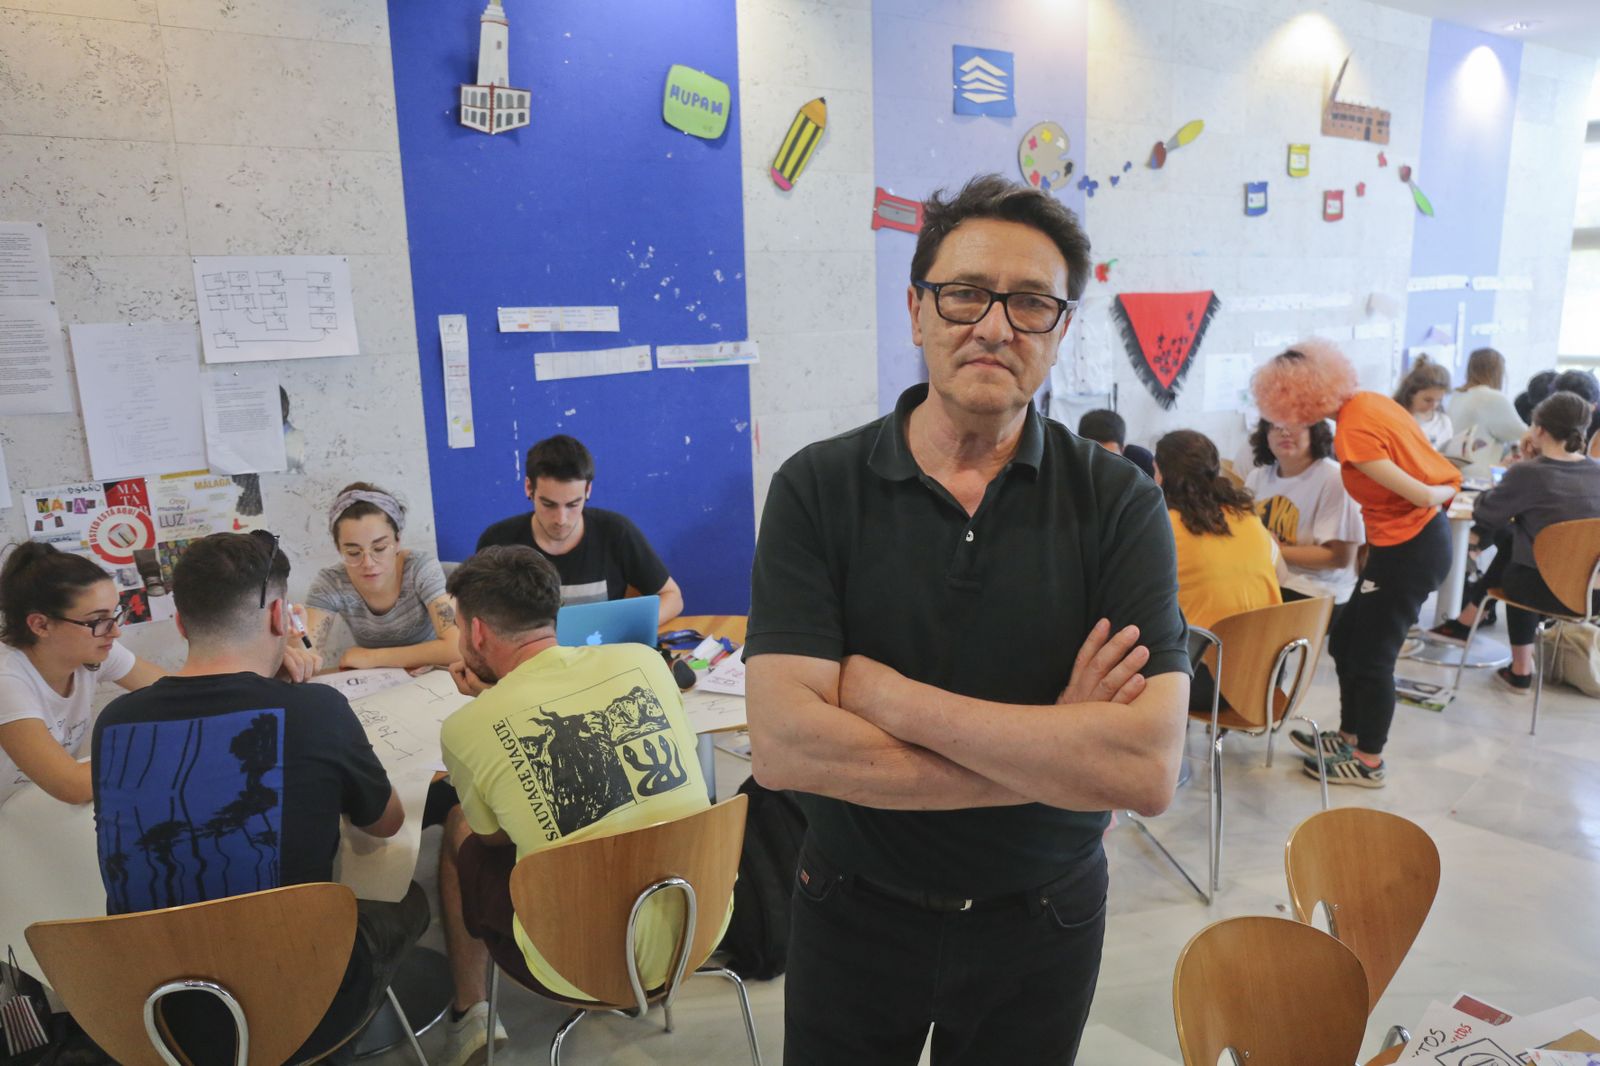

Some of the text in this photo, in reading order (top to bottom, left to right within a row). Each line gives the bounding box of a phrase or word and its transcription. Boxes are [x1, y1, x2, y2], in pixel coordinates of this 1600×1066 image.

[669, 83, 723, 117] HUPAM
[159, 512, 185, 529] LUZ
[492, 719, 560, 842] SAUVAGE VAGUE
